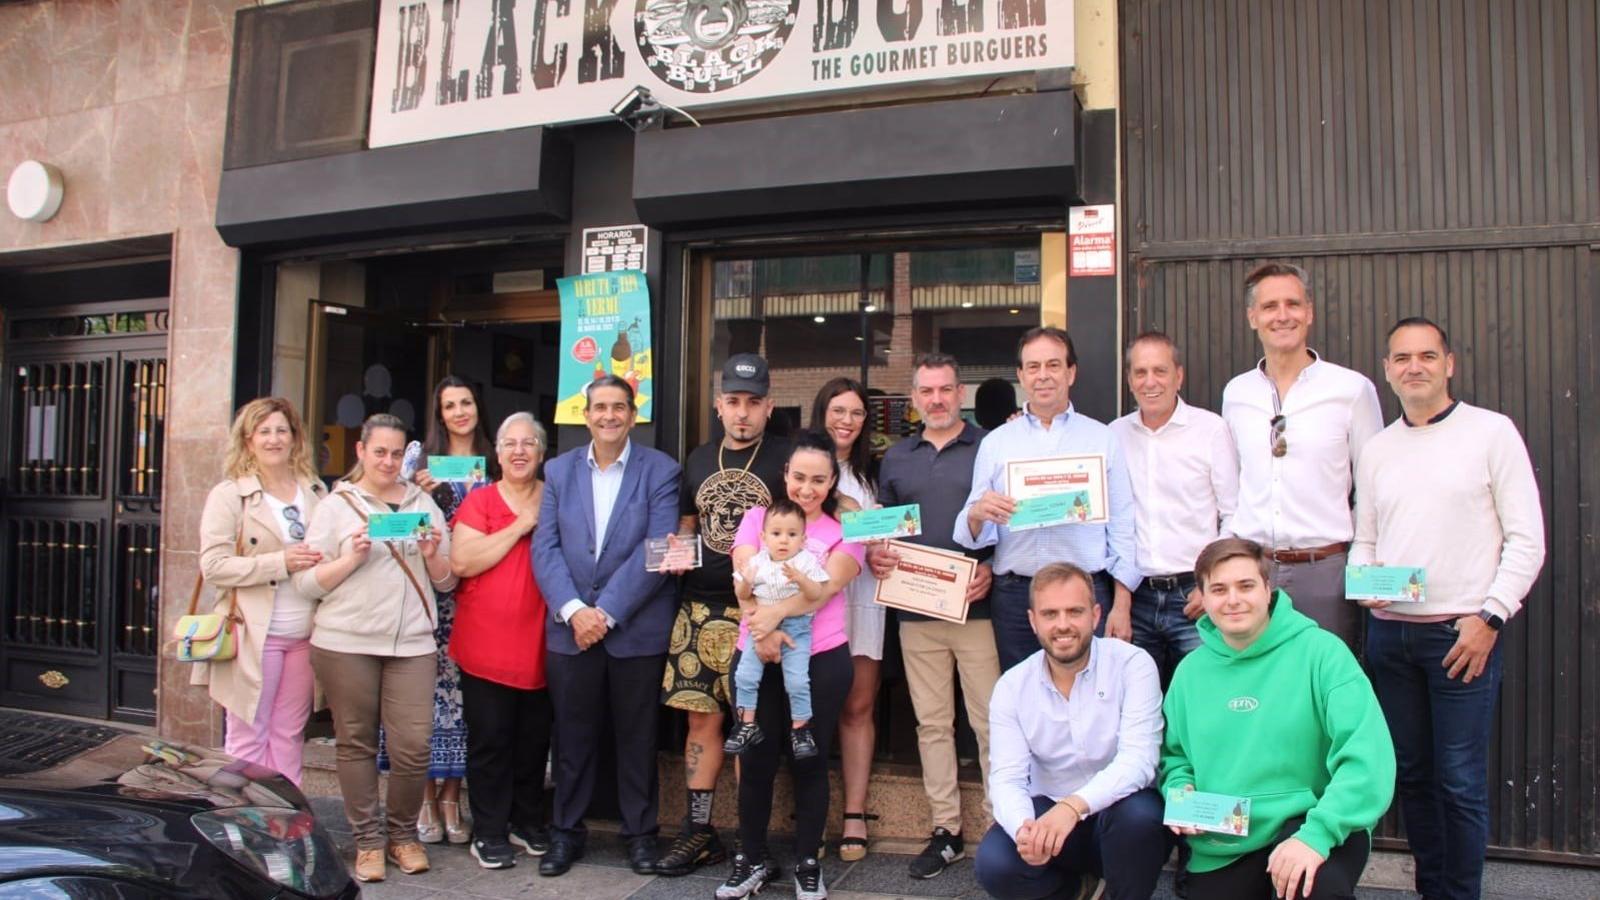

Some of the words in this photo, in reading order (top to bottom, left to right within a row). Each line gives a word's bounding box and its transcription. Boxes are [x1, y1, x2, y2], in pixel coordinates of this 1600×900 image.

[391, 0, 626, 114] BLACK
[653, 28, 780, 68] BLACK
[812, 57, 842, 81] THE
[850, 45, 938, 77] GOURMET
[947, 33, 1048, 66] BURGUERS
[668, 57, 763, 83] BULL
[597, 230, 633, 240] HORARIO
[1073, 235, 1112, 246] Alarma
